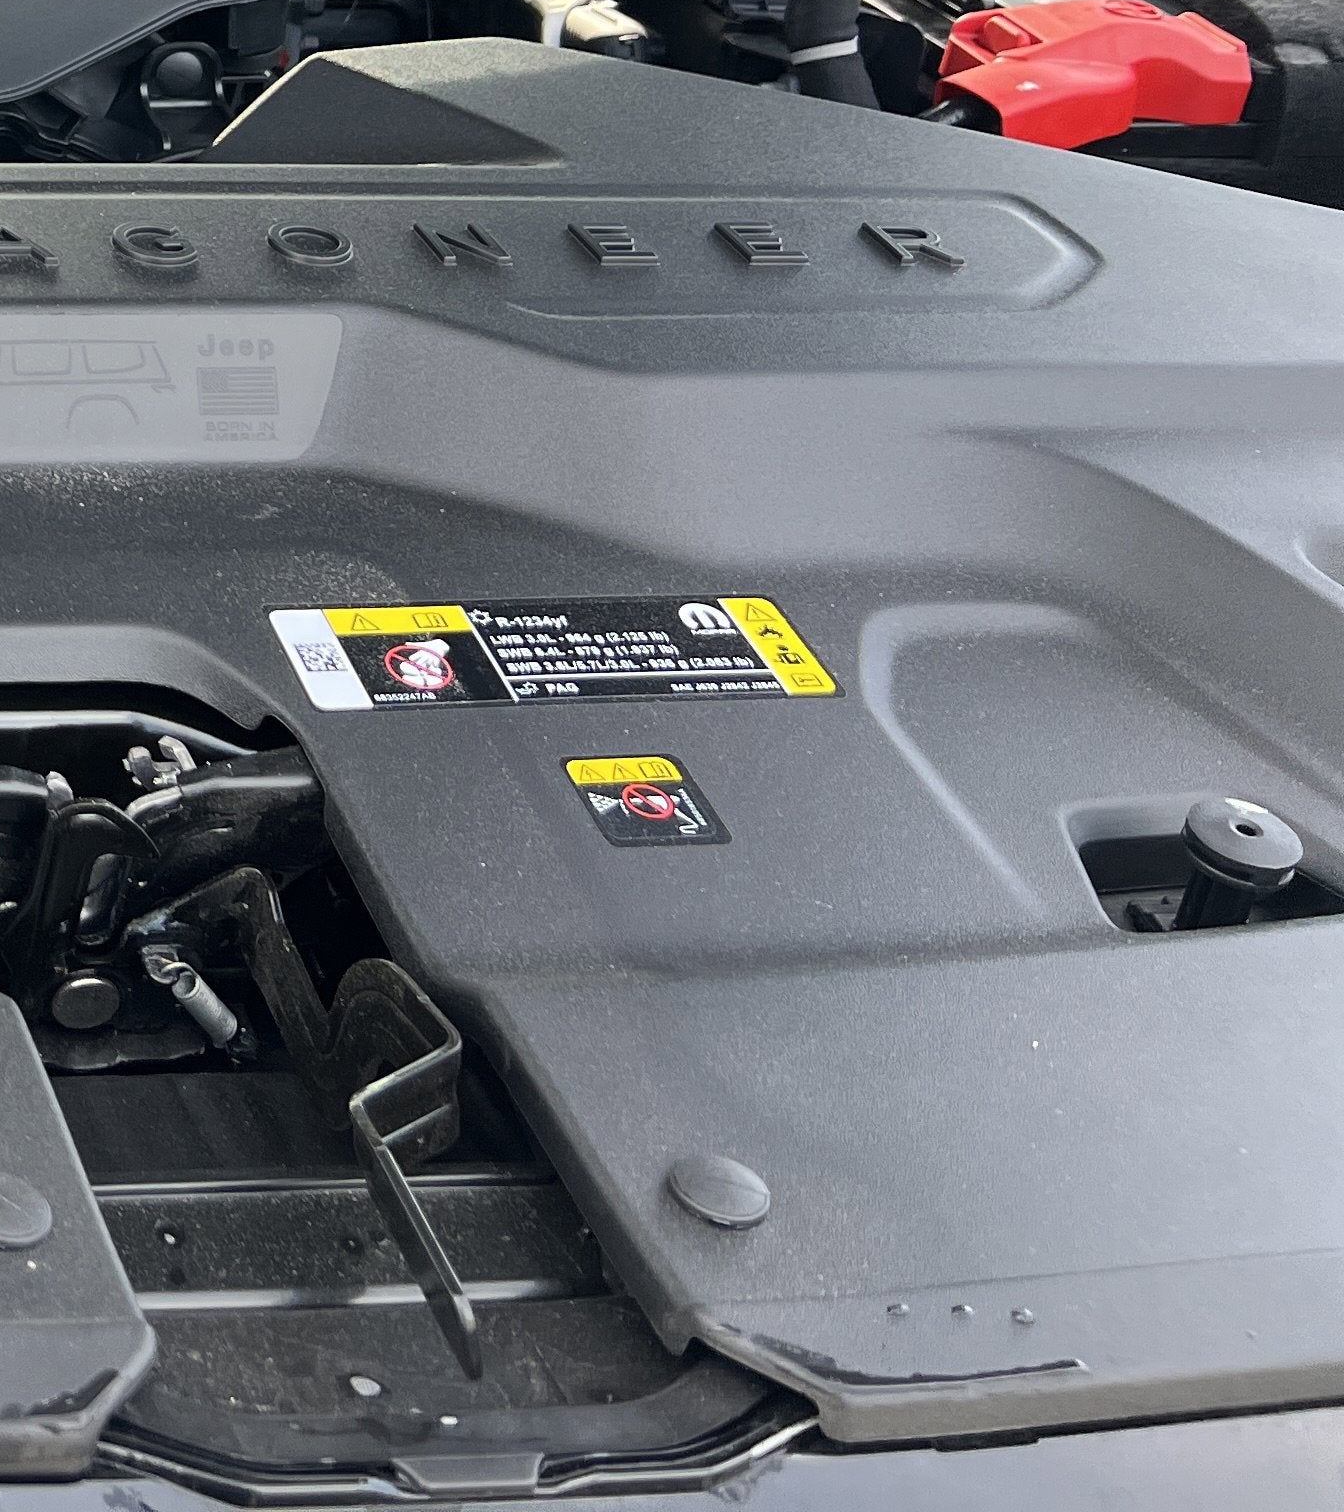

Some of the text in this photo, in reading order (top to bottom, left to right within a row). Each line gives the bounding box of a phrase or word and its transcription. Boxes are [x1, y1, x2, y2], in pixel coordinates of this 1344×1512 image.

[197, 333, 274, 360] Jeep
[206, 421, 252, 431] BORN
[203, 432, 280, 442] AMERICA
[494, 615, 568, 629] R-1234yf
